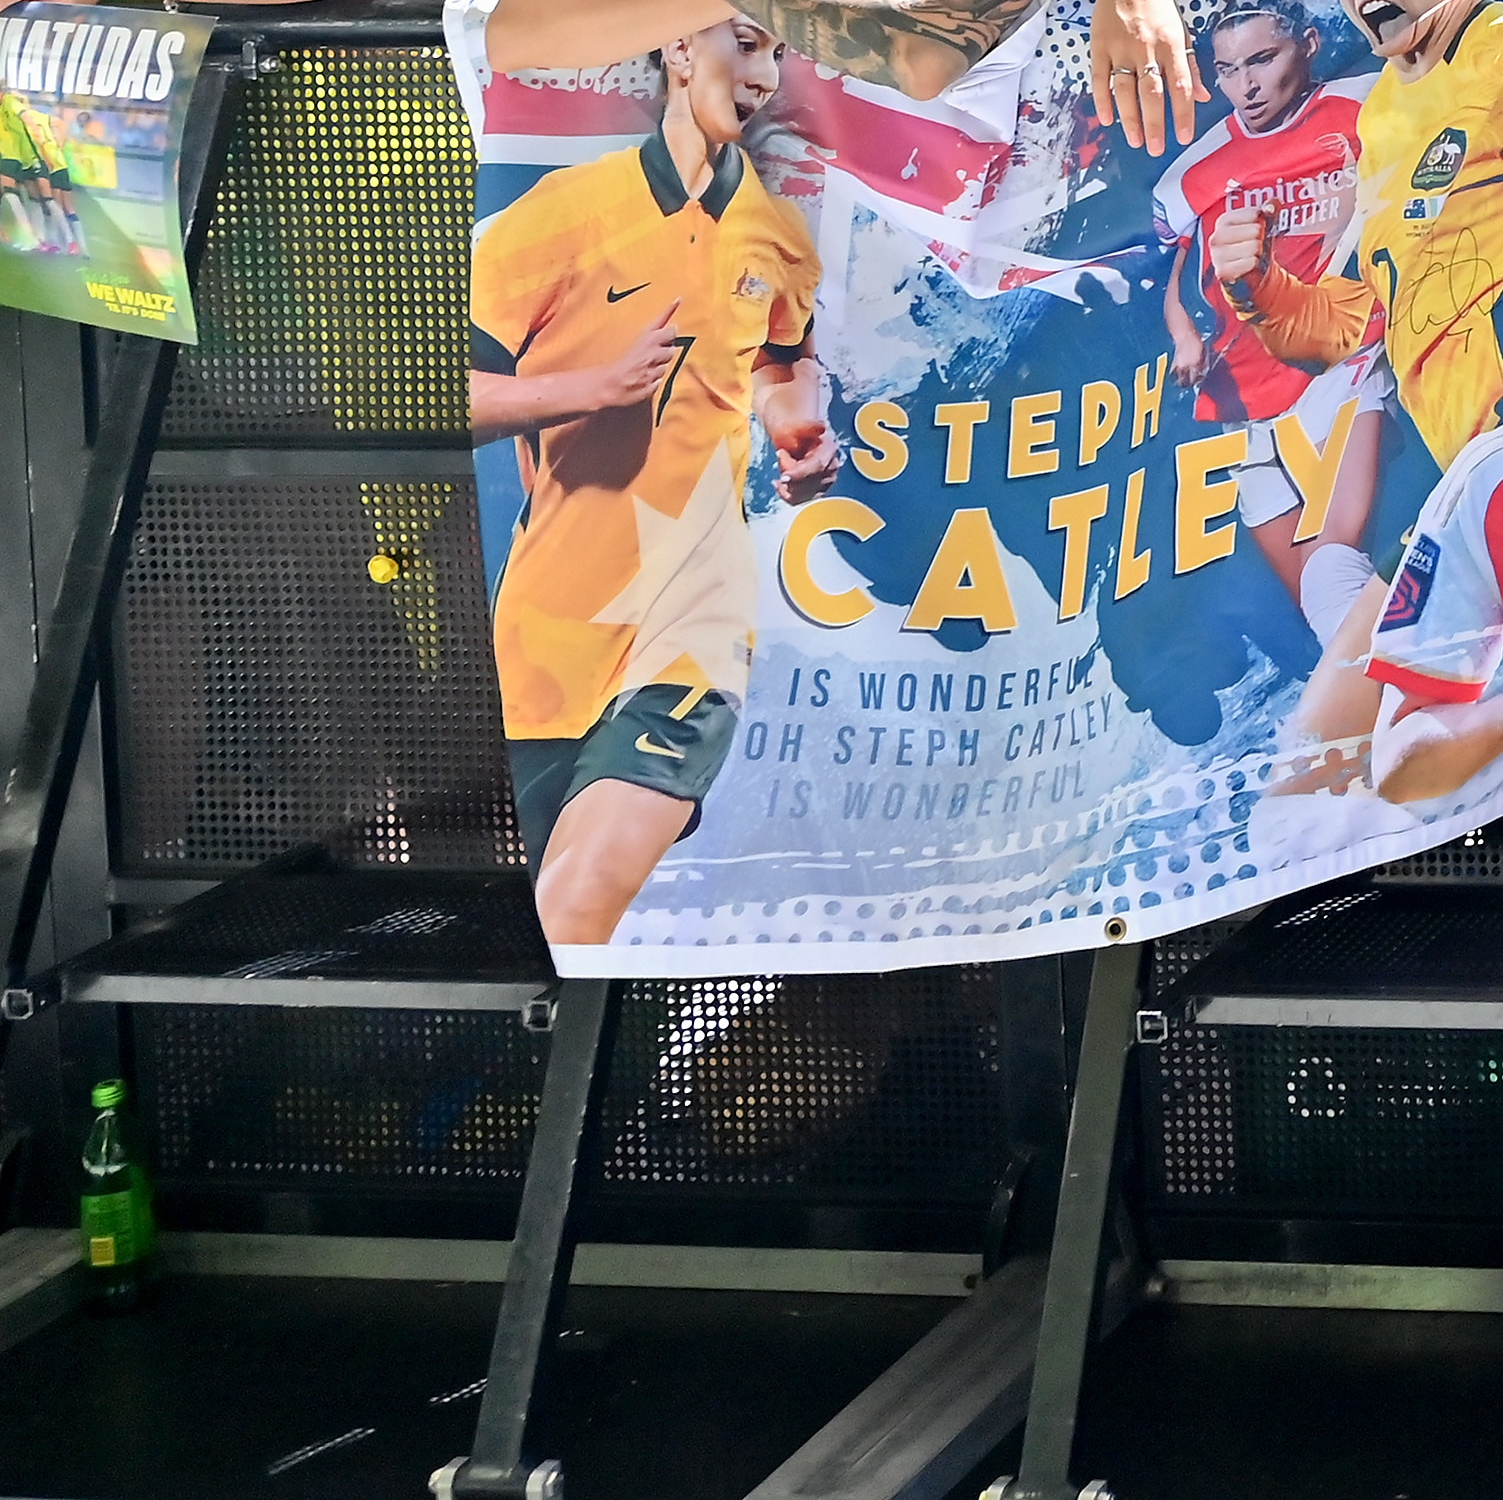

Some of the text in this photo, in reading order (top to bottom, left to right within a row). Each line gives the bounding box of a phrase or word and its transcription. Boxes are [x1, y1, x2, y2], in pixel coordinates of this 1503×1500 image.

[1276, 197, 1341, 231] BETTER
[86, 281, 177, 314] WE WALTZ
[849, 352, 1169, 483] STEPH
[778, 396, 1360, 633] CATLEY
[788, 654, 1095, 713] IS WONDERFUL
[744, 692, 1113, 767] OH STEPH CATLEY
[766, 759, 1086, 821] IS WONDERFUL
